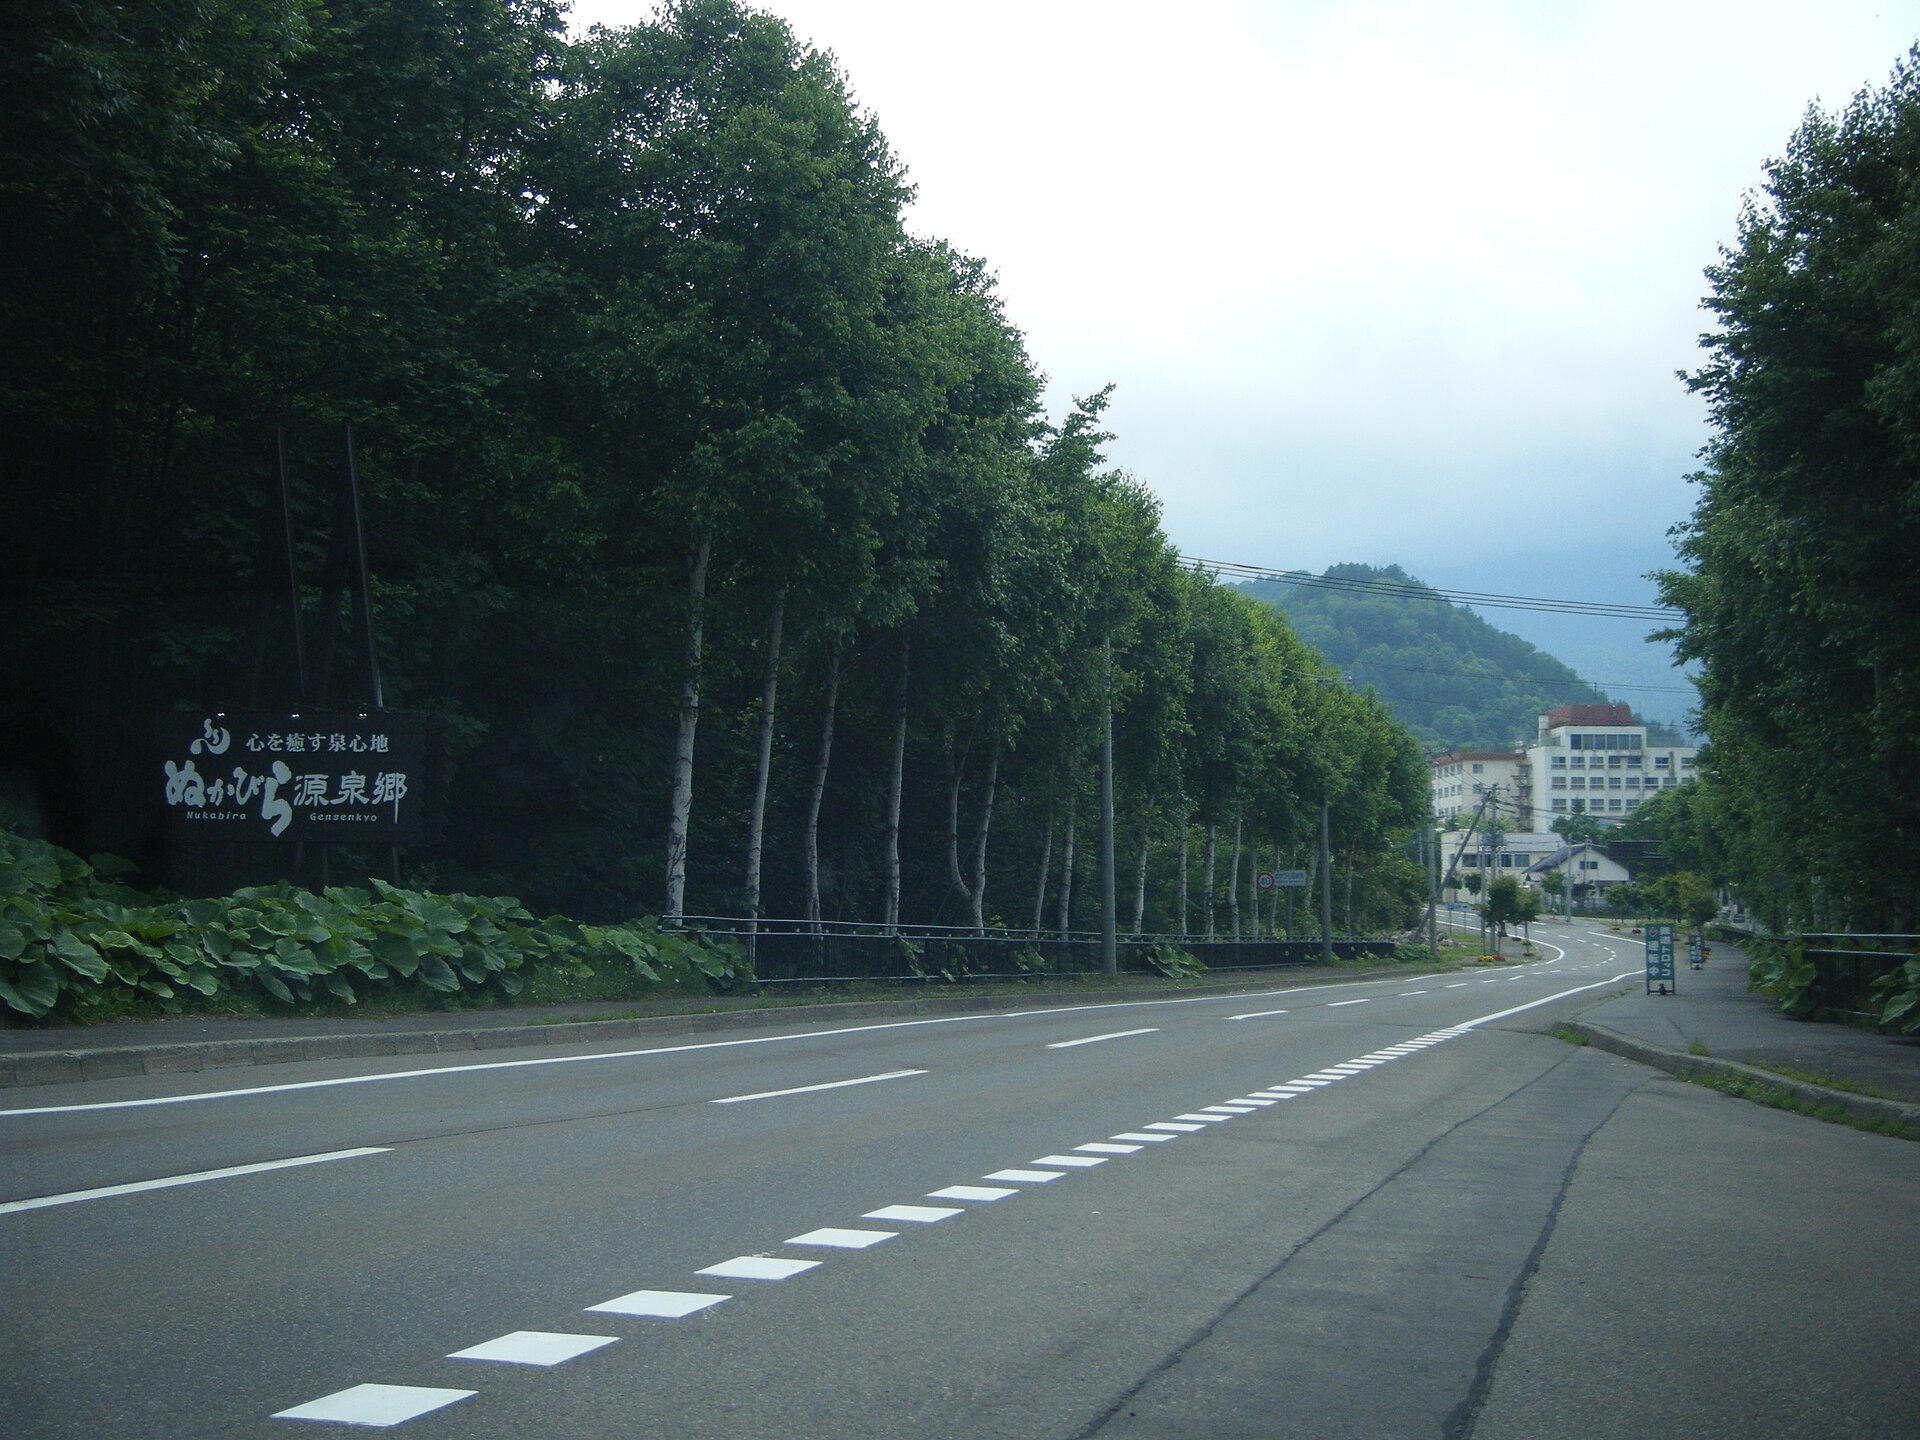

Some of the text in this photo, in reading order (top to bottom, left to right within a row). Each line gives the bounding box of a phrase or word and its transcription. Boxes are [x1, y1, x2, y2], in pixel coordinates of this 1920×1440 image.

[245, 732, 390, 753] 心を癒す泉心地
[186, 810, 378, 823] Nukabira Gensenkyo
